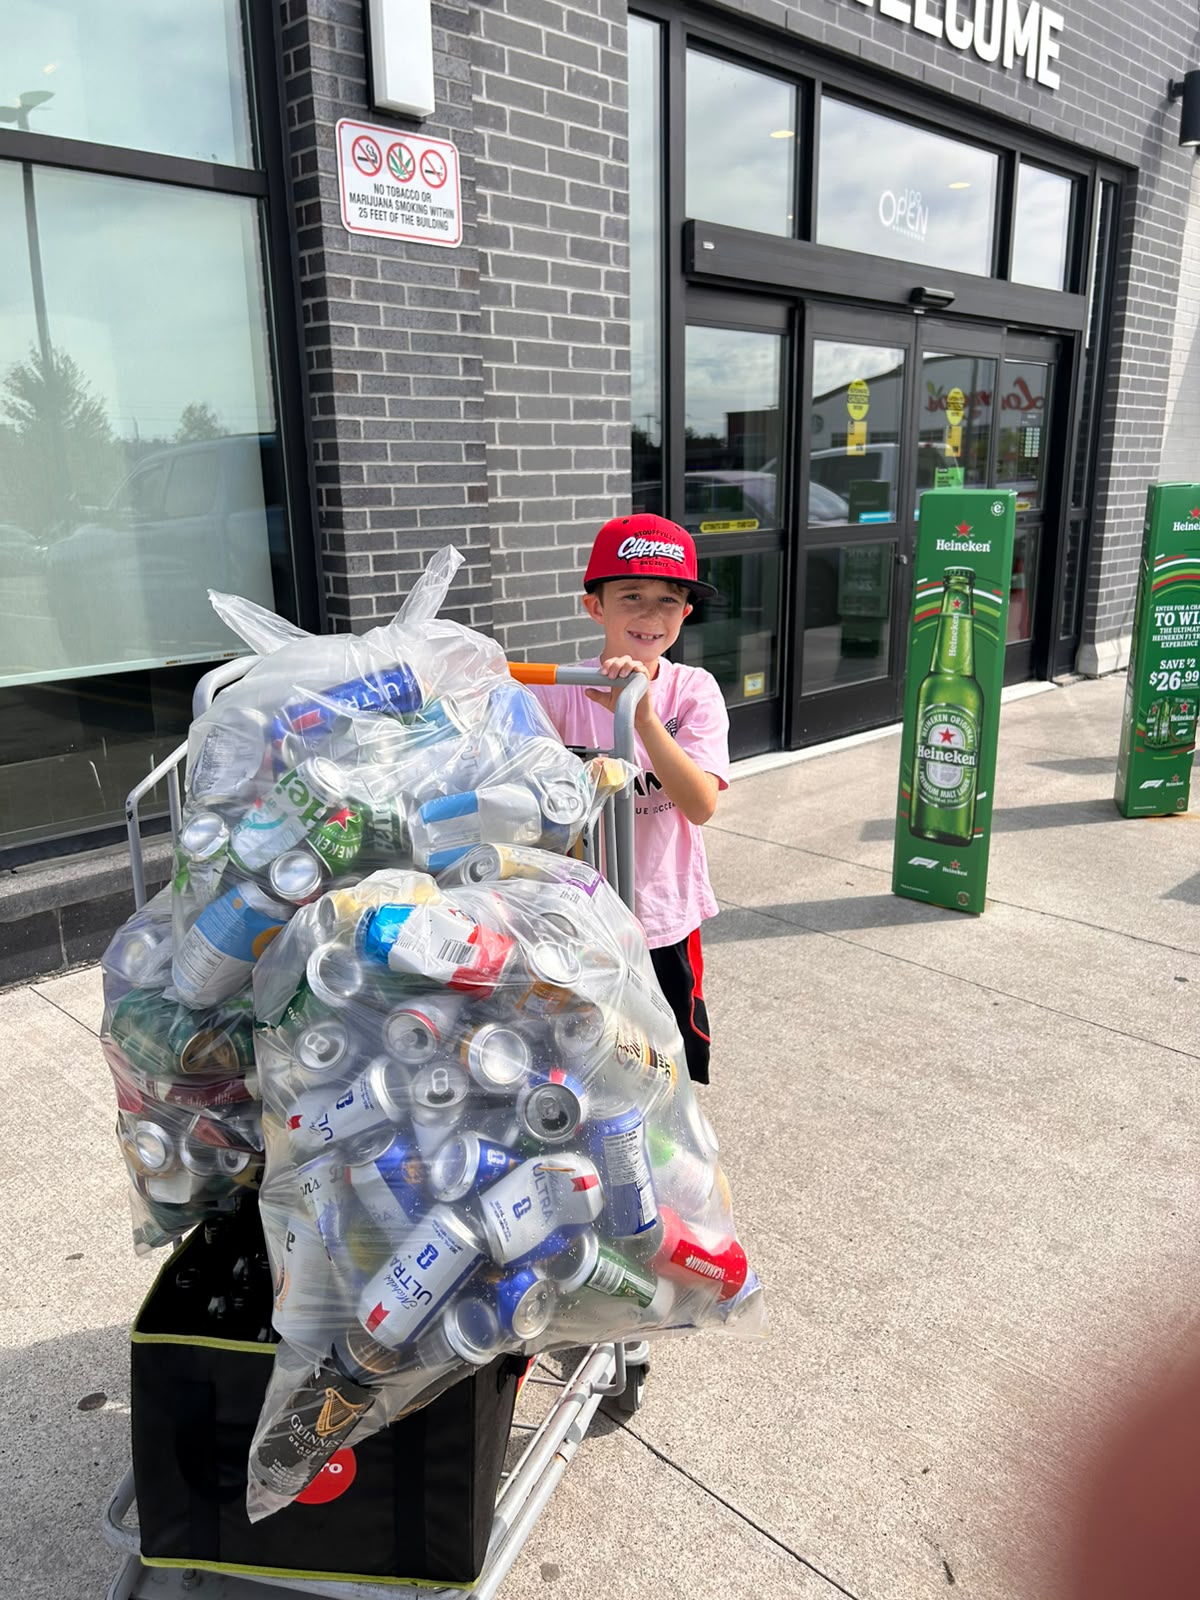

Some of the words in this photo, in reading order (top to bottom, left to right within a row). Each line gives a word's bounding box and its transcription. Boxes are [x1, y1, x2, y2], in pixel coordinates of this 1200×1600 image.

[856, 0, 1064, 90] COME
[374, 183, 385, 195] NO
[386, 186, 420, 201] TOBACCO
[421, 191, 432, 203] OR
[349, 192, 393, 209] MARIJUANA
[395, 200, 429, 215] SMOKING
[429, 207, 455, 219] WITHIN
[879, 190, 929, 235] OPEN
[358, 207, 369, 219] 25
[370, 209, 388, 221] FEET
[389, 211, 399, 223] OF
[400, 213, 415, 225] THE
[416, 218, 449, 231] BUILDING
[617, 536, 685, 559] Clippers
[936, 539, 992, 553] Heineken
[1154, 611, 1176, 627] TO
[1179, 610, 1200, 626] WI
[949, 613, 960, 657] Heineken
[1152, 634, 1184, 642] HEINEKEN
[1161, 639, 1199, 649] EXPERIENCE
[1160, 659, 1186, 670] SAVE
[1187, 658, 1196, 668] $2
[1149, 670, 1200, 691] $26.99
[922, 713, 948, 738] HEINEKEN
[950, 715, 974, 744] ORIGINAL
[917, 744, 976, 766] Heineken
[920, 771, 940, 798] PREMIUM
[940, 790, 957, 798] MALT
[957, 778, 971, 796] LAGER
[652, 801, 676, 815] SOCCE
[532, 1162, 554, 1225] ULTRA
[389, 1254, 433, 1306] ULTRA
